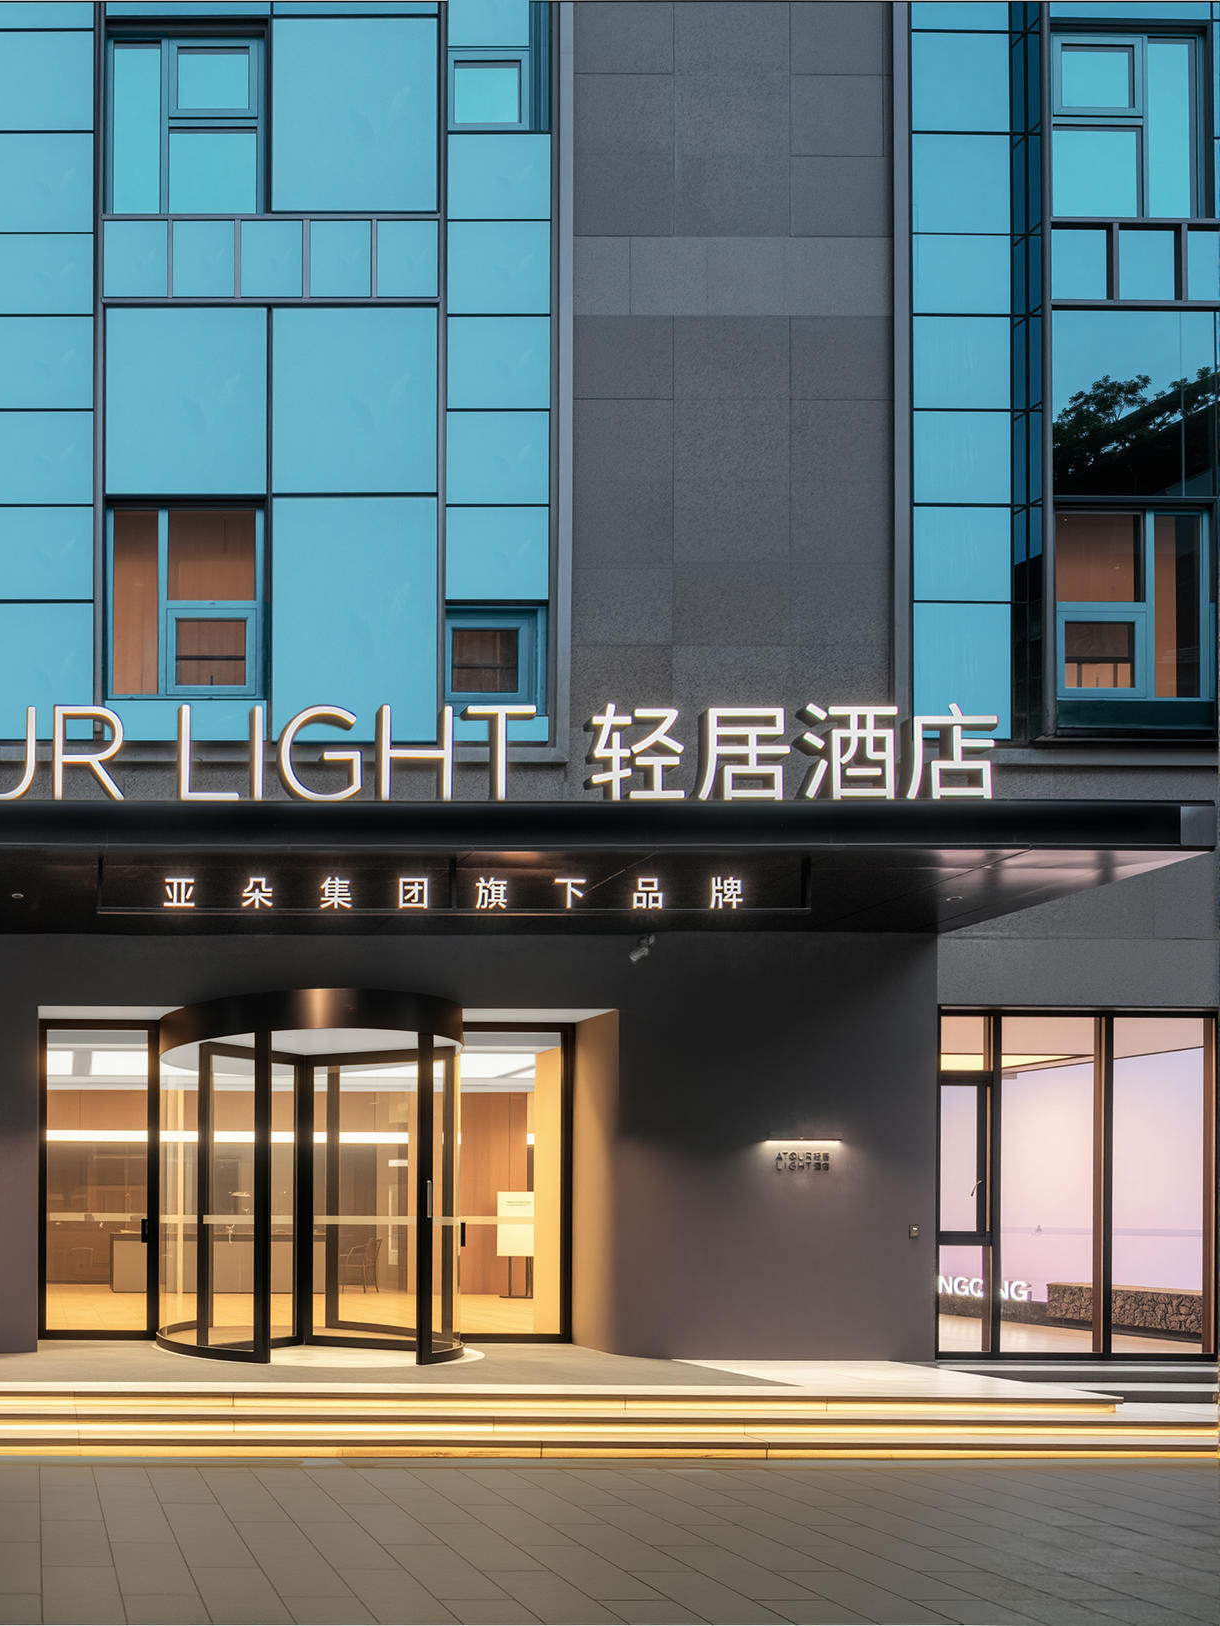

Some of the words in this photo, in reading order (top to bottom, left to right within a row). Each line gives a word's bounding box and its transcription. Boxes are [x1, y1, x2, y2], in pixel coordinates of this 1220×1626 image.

[178, 702, 537, 801] LIGHT
[591, 702, 999, 801] 轻居酒店
[163, 876, 744, 910] 亚朵集团旗下品牌
